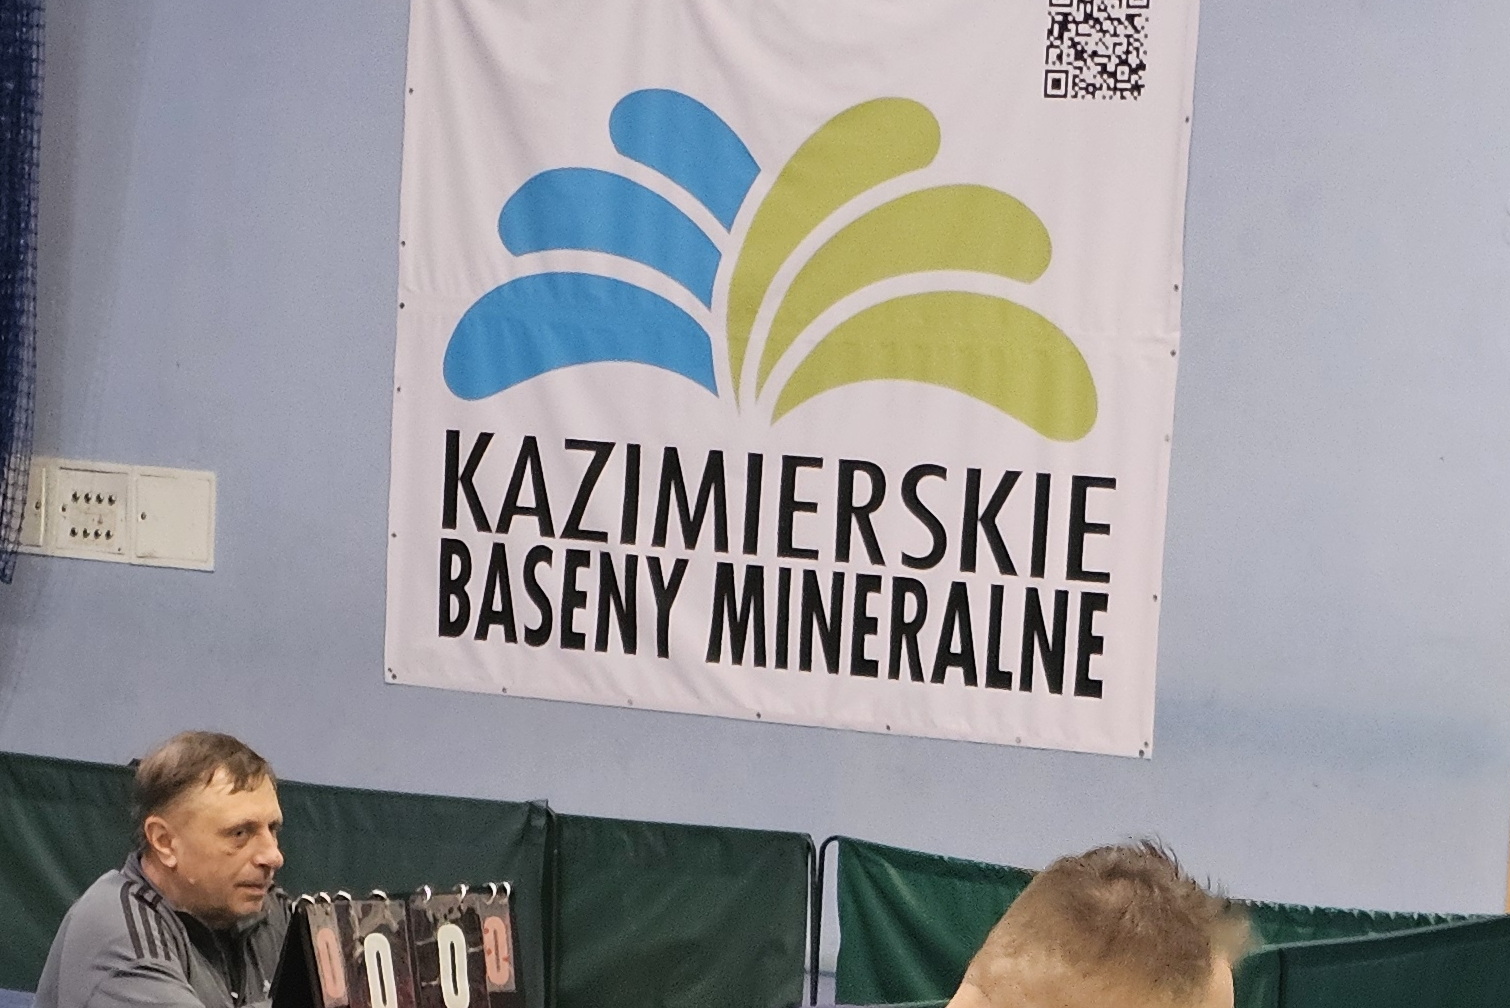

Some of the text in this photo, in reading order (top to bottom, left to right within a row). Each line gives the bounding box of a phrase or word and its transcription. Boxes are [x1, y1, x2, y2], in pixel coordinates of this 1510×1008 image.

[441, 429, 1117, 584] KAZIMIERSKIE
[437, 537, 1110, 700] BASENY MINERALNE
